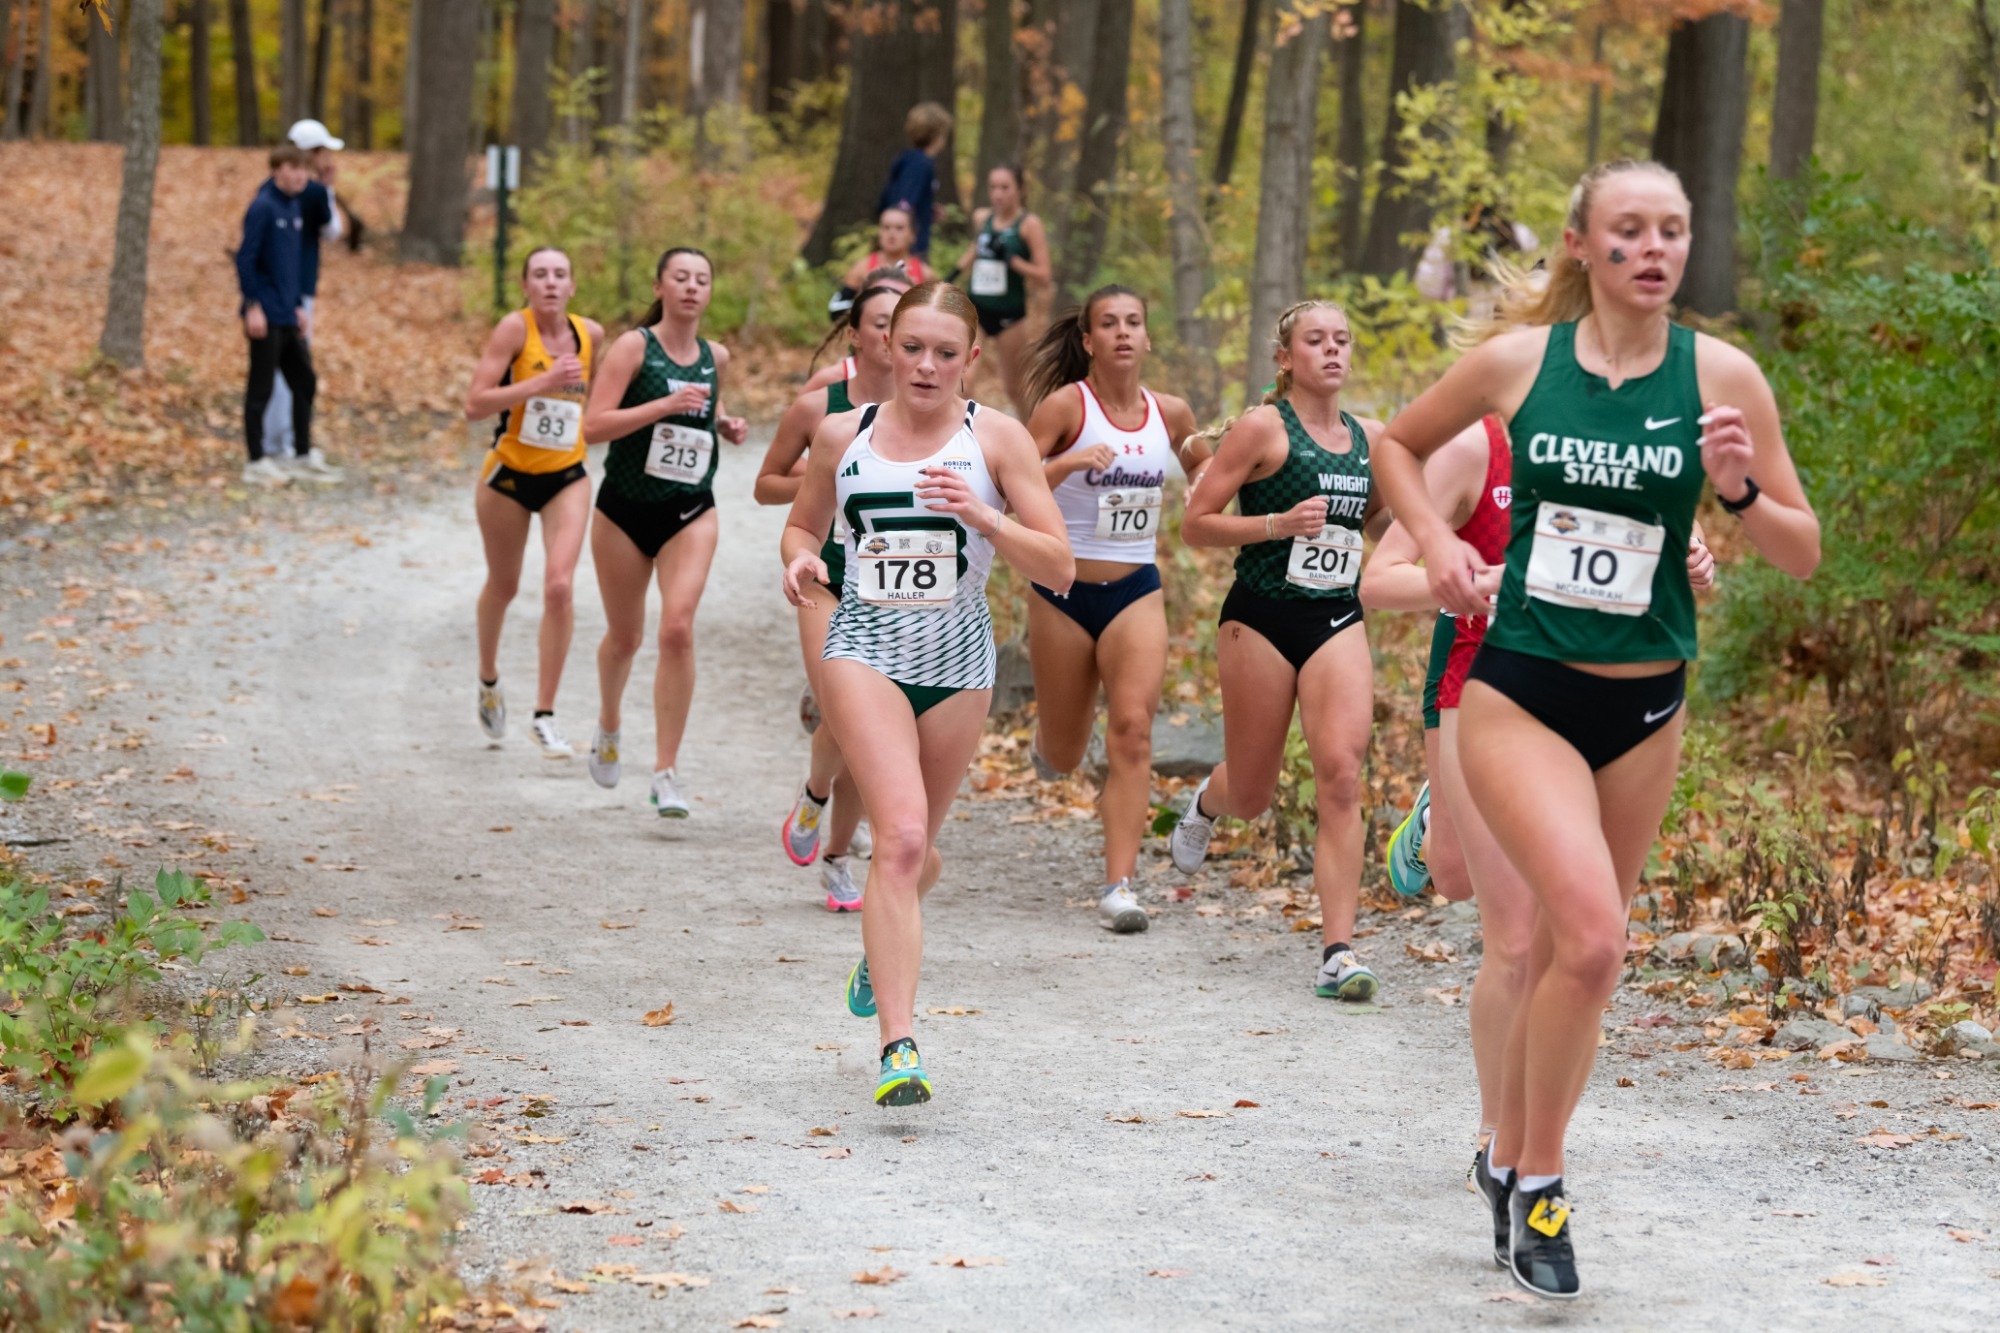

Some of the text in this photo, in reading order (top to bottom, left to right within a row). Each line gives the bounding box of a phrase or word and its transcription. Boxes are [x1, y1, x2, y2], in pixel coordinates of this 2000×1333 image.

[537, 415, 565, 437] 83
[660, 444, 698, 469] 213
[1528, 432, 1683, 478] CLEVELAND
[1318, 473, 1369, 494] WRIGHT
[1563, 462, 1639, 490] STATE
[1110, 508, 1148, 532] 170
[1302, 546, 1350, 575] 201
[1569, 545, 1618, 586] 10
[874, 559, 937, 590] 178
[1309, 571, 1337, 581] BARNITZ
[887, 591, 925, 599] HALLER
